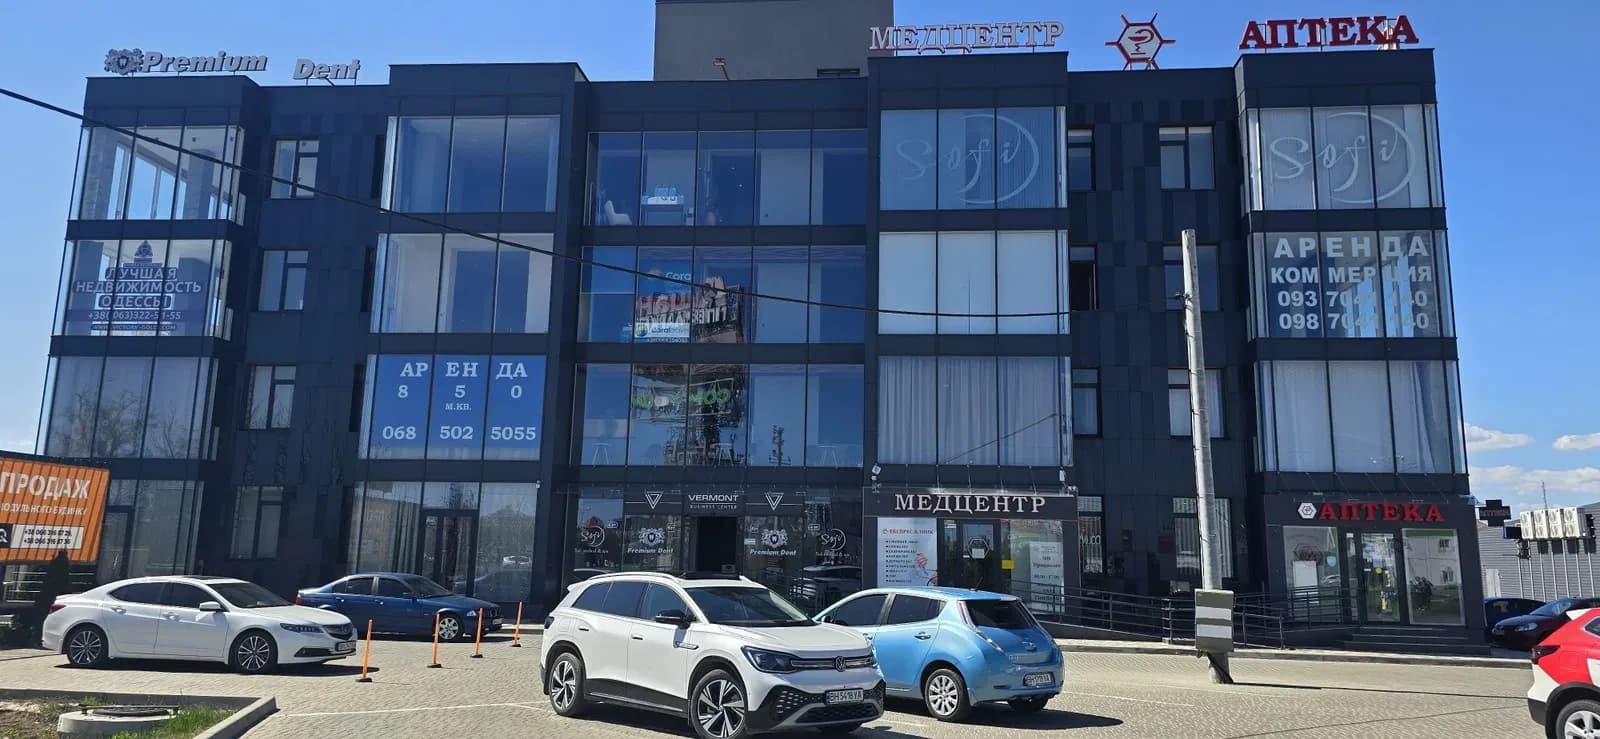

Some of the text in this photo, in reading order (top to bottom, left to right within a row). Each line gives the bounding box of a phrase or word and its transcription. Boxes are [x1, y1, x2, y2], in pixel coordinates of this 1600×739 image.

[869, 21, 1064, 54] МЕДЦЕНТР
[1239, 15, 1419, 50] АПТЕКА
[142, 52, 360, 80] Premium Dent
[1273, 236, 1430, 261] АРЕНДА
[106, 268, 177, 279] ЛУЧШАЯ
[76, 281, 201, 293] НЕДВИЖИМОСТЬ
[101, 296, 168, 308] ОДЕССЫ
[1278, 290, 1317, 307] 093
[1279, 313, 1319, 329] 098
[382, 426, 536, 440] 068 502 5055
[1, 472, 91, 500] ПРОДАЖ
[688, 494, 739, 502] VERMONT
[895, 494, 1046, 514] МЕДЦЕНТР
[1319, 502, 1445, 522] АПТЕКА
